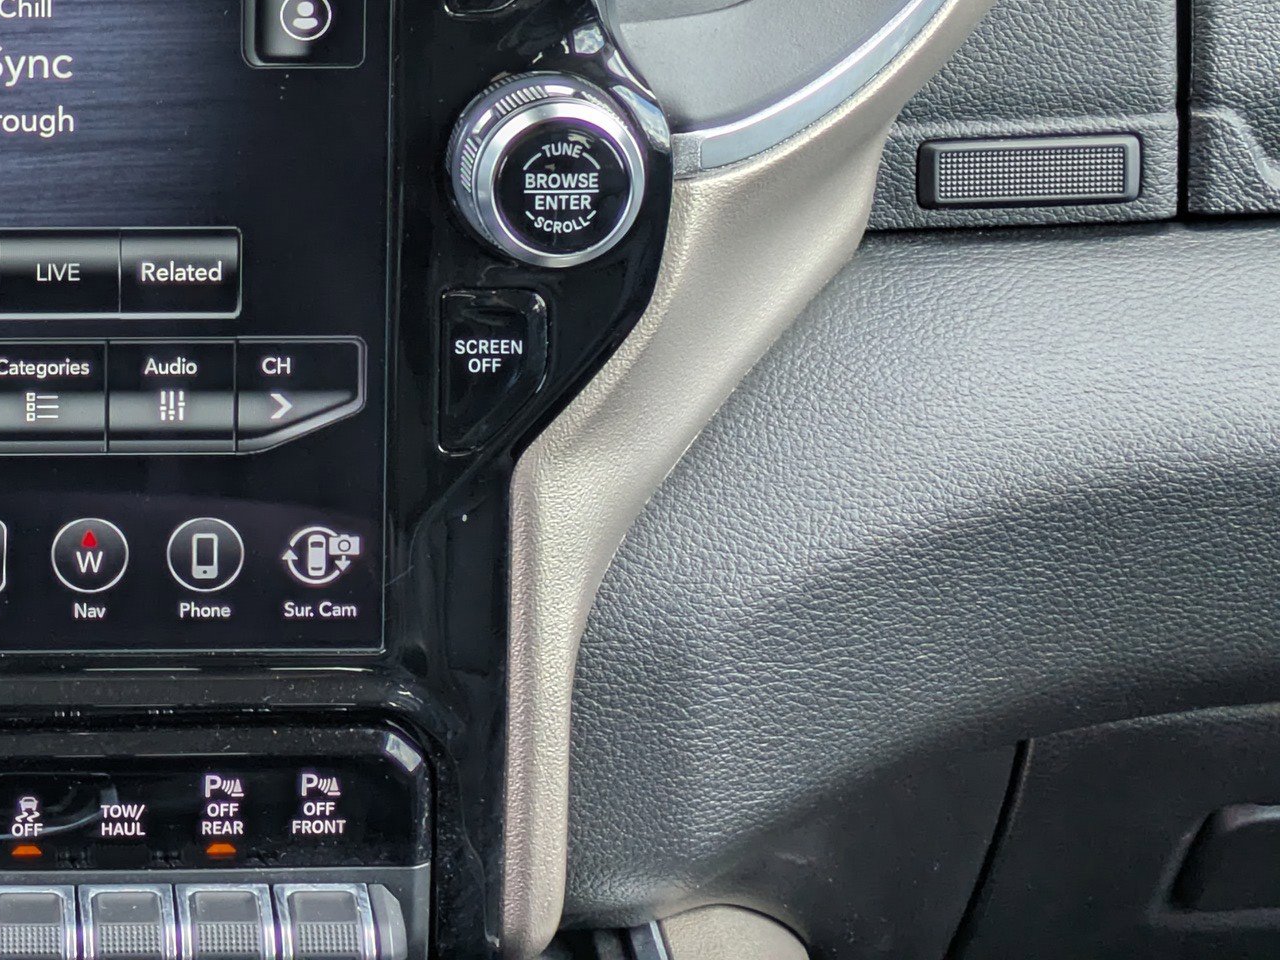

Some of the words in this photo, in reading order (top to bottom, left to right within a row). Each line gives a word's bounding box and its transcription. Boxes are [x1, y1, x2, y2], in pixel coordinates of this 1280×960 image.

[541, 142, 582, 159] TUNE
[524, 173, 599, 189] BROWSE
[534, 195, 591, 210] ENTER
[532, 214, 591, 234] SCROLL
[36, 263, 81, 282] LIVE
[140, 262, 223, 283] Related
[454, 339, 522, 355] SCREEN
[144, 358, 198, 376] Audio
[261, 357, 291, 375] CH
[468, 358, 502, 373] OFF
[75, 551, 104, 573] W
[74, 603, 106, 619] Nav
[179, 602, 231, 618] Phone
[284, 602, 314, 618] Sur.
[319, 602, 357, 618] Cam
[100, 804, 146, 820] TOW/
[207, 803, 238, 817] OFF
[303, 802, 335, 816] OFF
[11, 823, 43, 837] OFF
[101, 822, 146, 836] HAUL
[202, 821, 244, 835] REAR
[292, 820, 346, 834] FRONT
